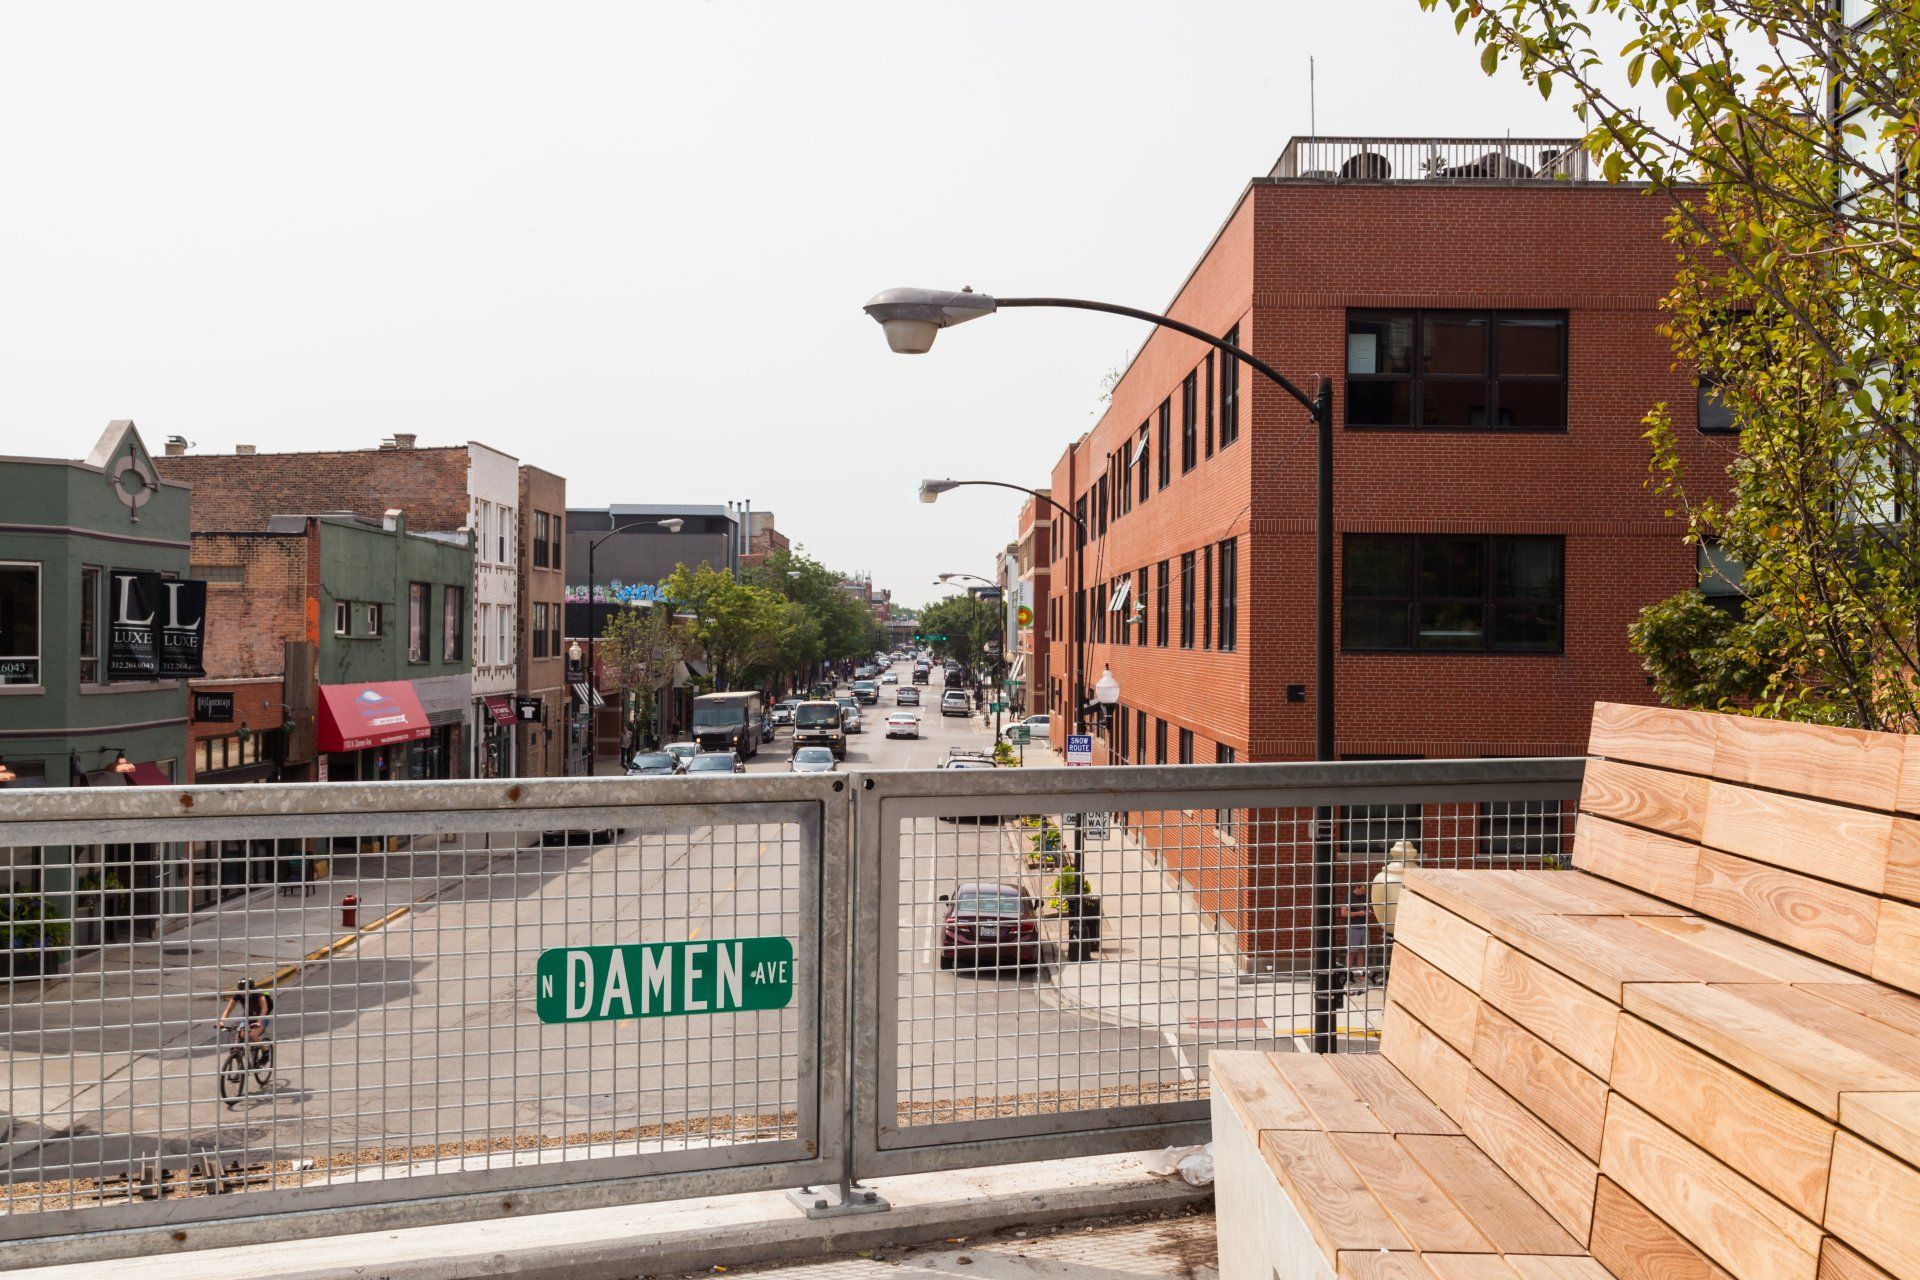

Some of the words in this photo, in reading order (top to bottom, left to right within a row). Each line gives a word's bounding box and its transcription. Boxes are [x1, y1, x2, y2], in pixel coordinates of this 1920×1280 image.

[114, 575, 155, 625] L
[163, 582, 201, 630] L
[114, 631, 153, 644] LUXE
[164, 635, 198, 647] LUXE
[111, 661, 154, 669] 312.264.6043
[1070, 737, 1089, 745] SNOW
[1069, 744, 1090, 752] ROUTE
[1088, 819, 1108, 828] WAY
[542, 974, 553, 998] N
[566, 941, 743, 1019] DAMEN
[755, 960, 788, 985] AVE
